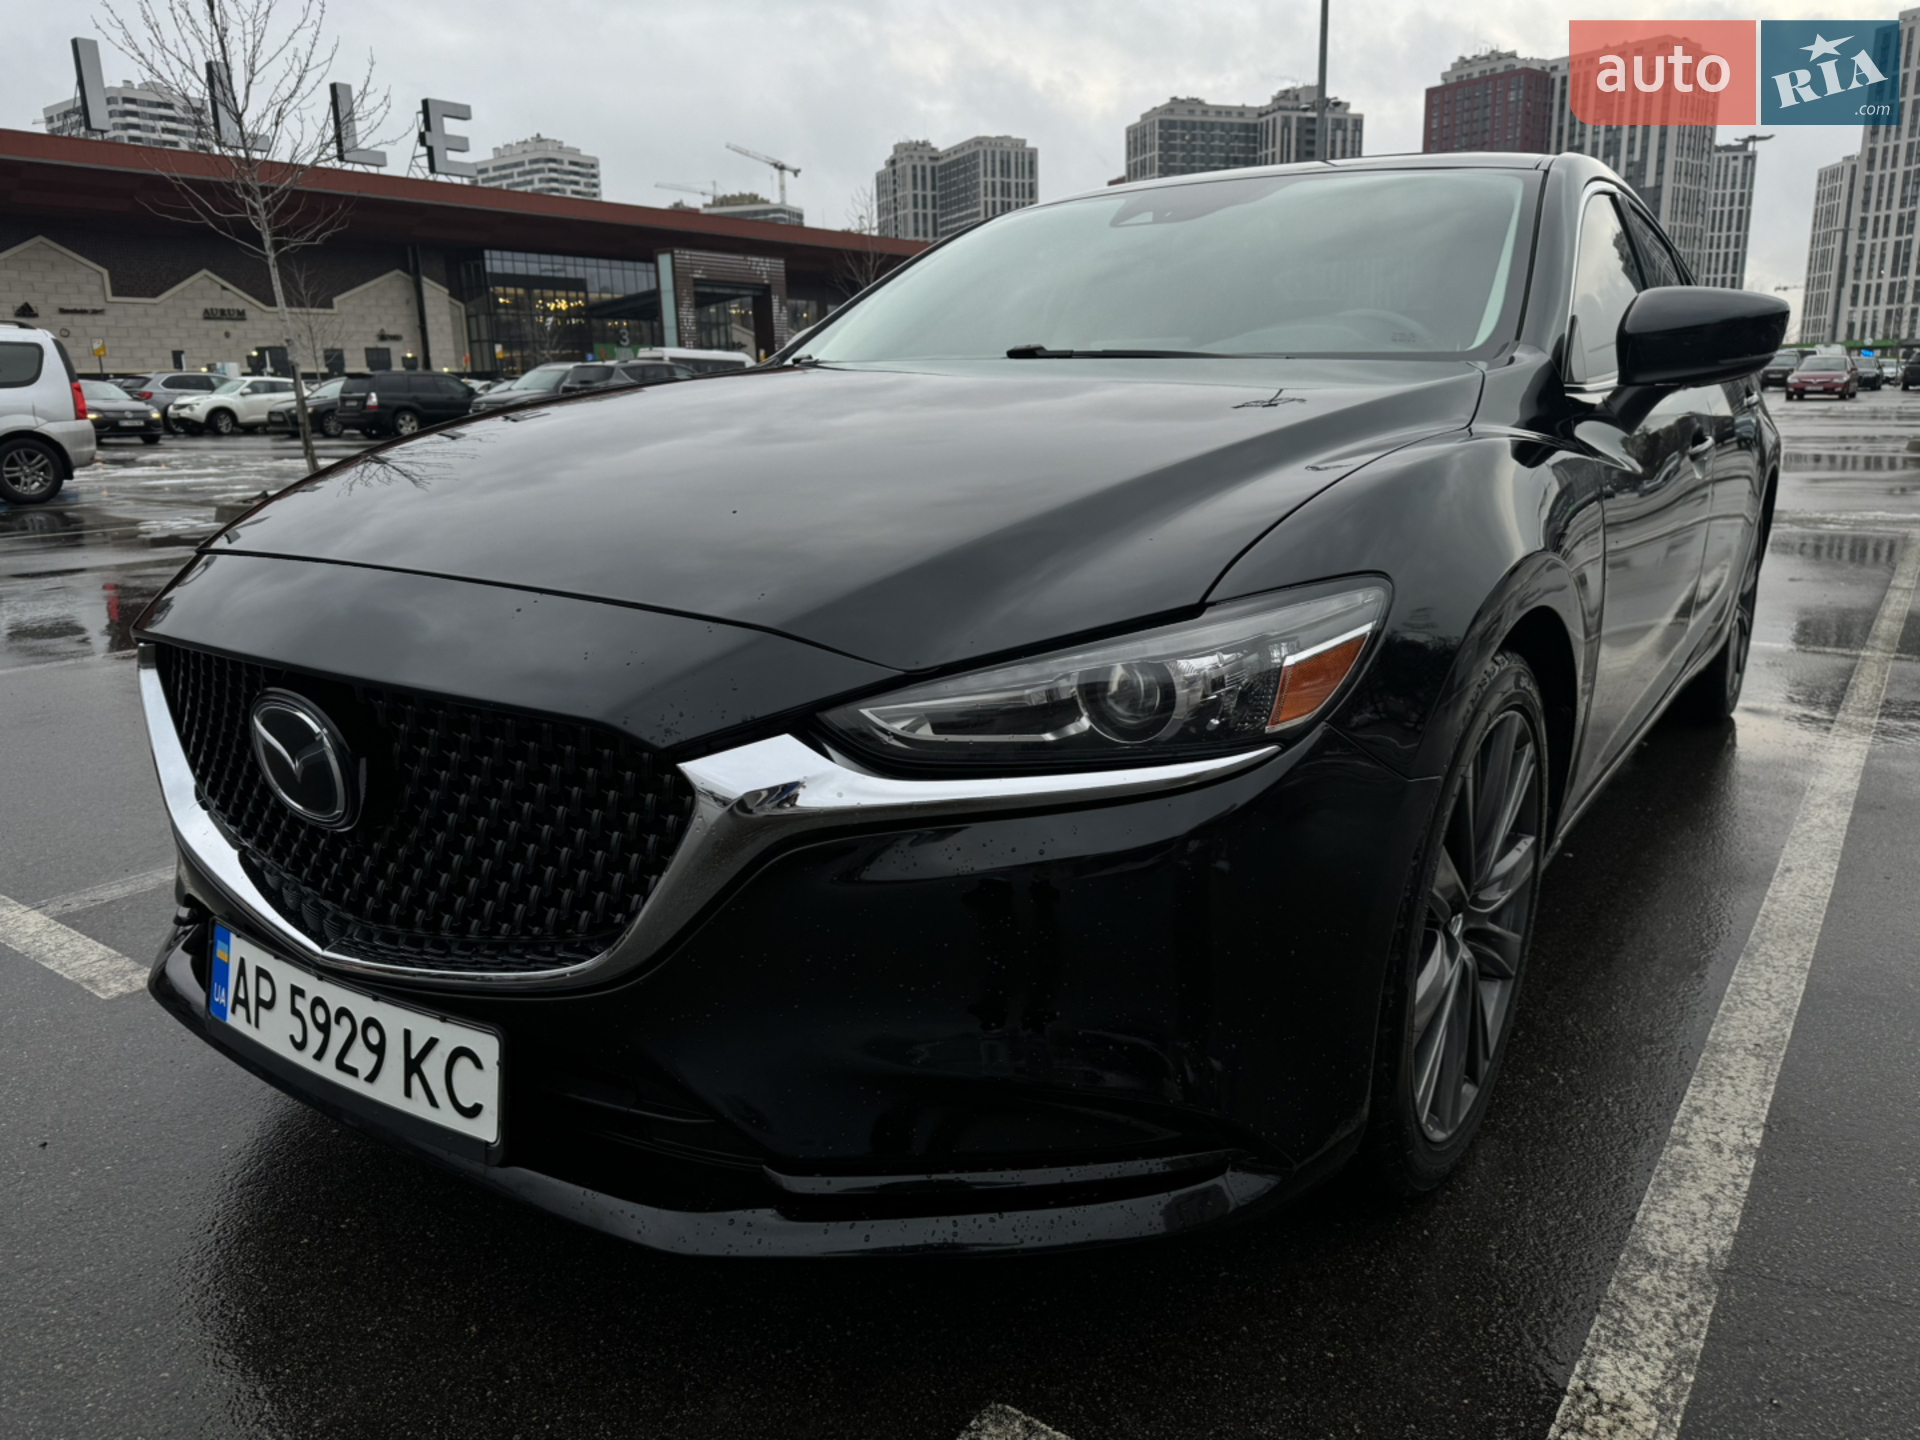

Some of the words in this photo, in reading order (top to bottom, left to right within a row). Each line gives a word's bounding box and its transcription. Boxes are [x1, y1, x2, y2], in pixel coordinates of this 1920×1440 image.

[203, 307, 246, 317] AURUM
[619, 328, 630, 346] 3
[213, 982, 227, 1007] UA
[230, 956, 277, 1030] AP
[289, 983, 387, 1084] 5929
[403, 1027, 484, 1119] KC
